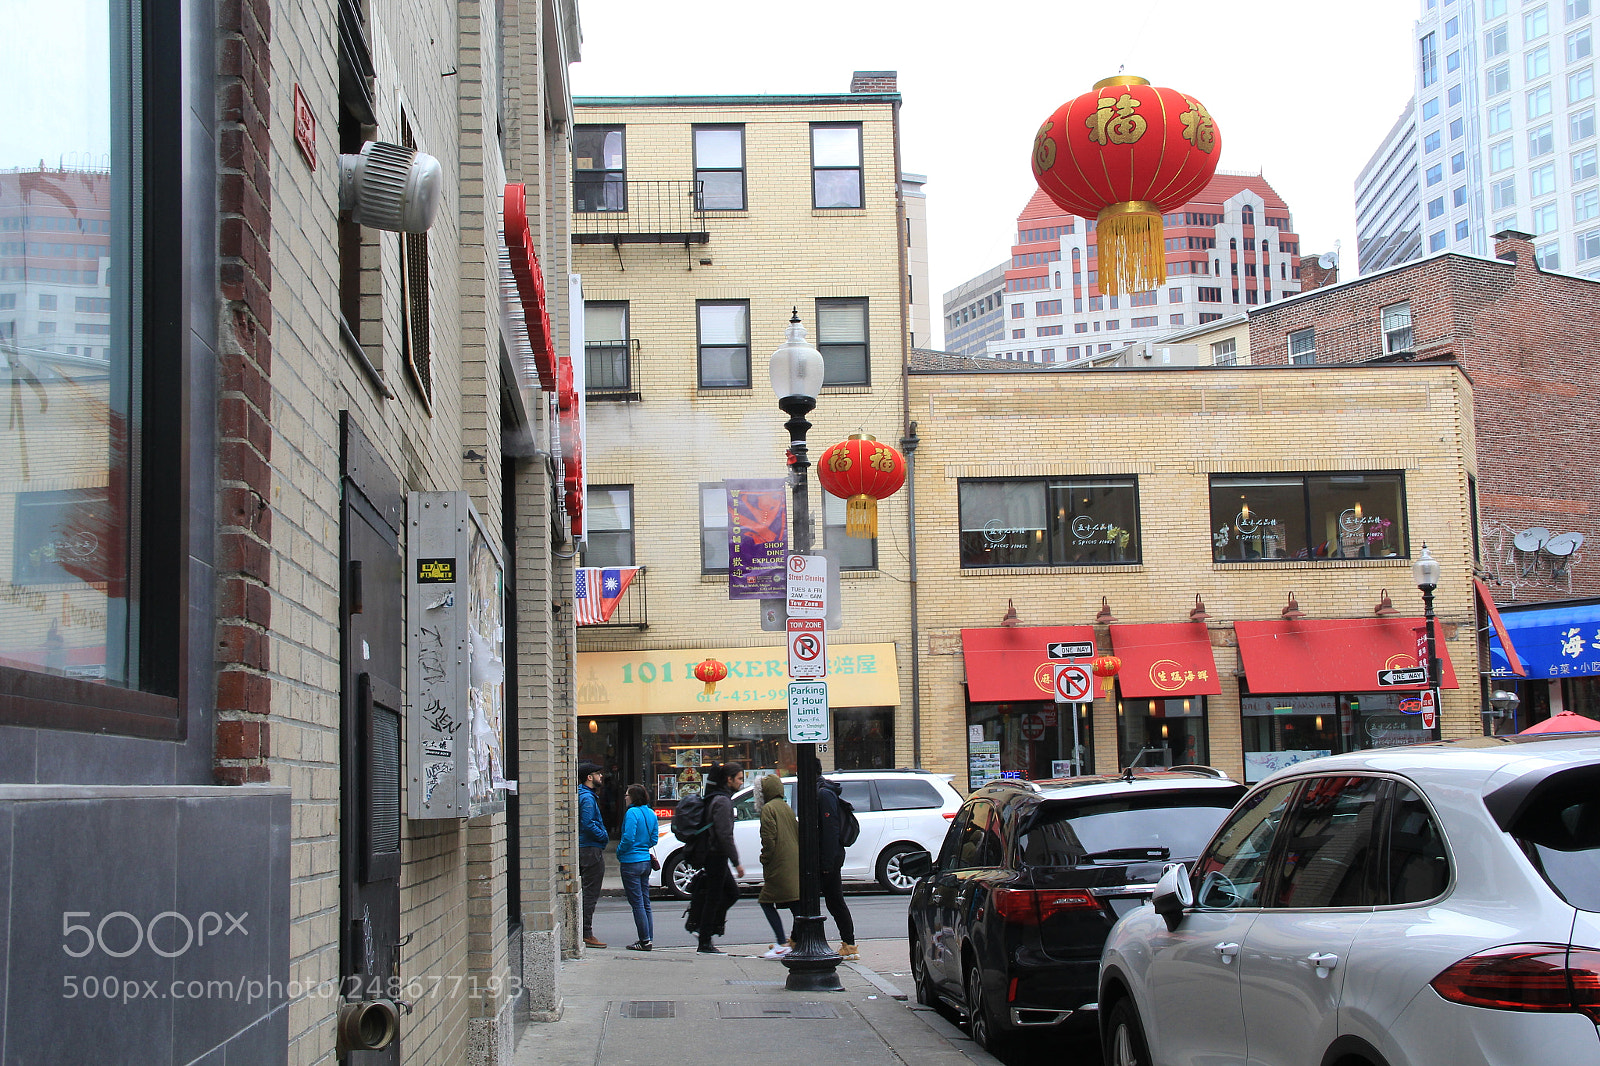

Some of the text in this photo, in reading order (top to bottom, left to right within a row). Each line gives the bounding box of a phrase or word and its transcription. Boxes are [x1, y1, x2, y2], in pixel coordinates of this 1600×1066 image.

[1085, 94, 1147, 146] 福
[730, 490, 742, 553] WELCOME
[789, 573, 803, 581] Street
[790, 621, 822, 630] TOW ZONE
[622, 662, 674, 684] 101
[1392, 673, 1405, 681] ONE
[791, 687, 825, 697] Parking
[792, 697, 824, 705] 2 Hour
[797, 706, 820, 716] Limit
[818, 744, 828, 753] 56
[654, 809, 672, 818] PEN
